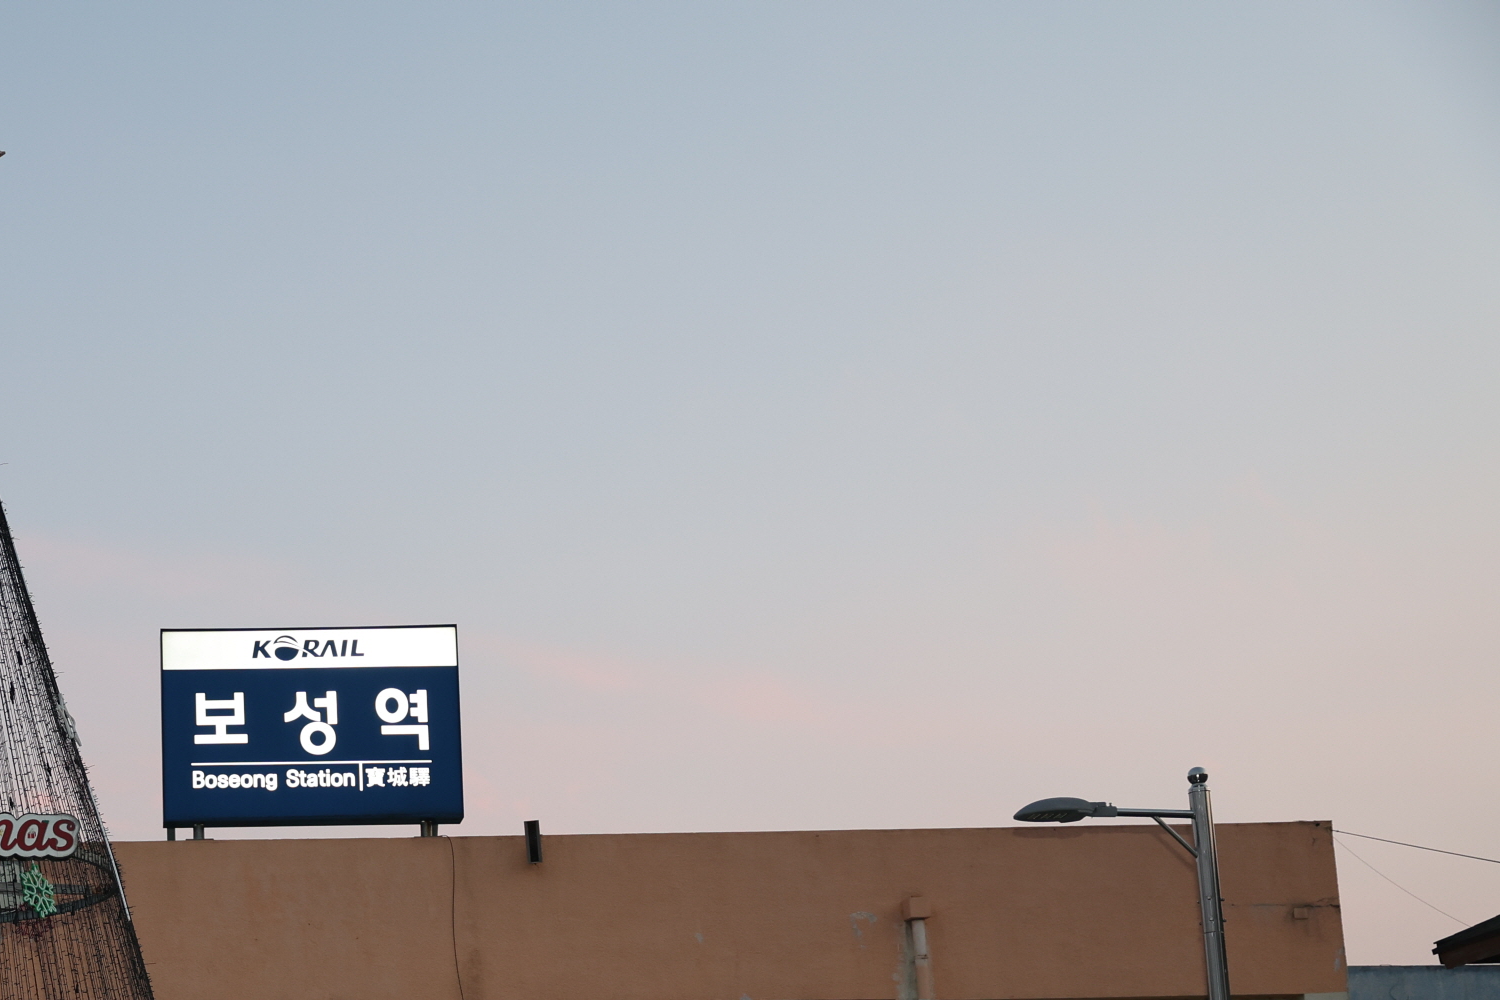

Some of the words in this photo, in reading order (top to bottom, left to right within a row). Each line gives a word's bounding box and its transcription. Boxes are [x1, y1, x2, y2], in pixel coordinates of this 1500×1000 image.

[252, 635, 365, 661] KORAIL
[193, 687, 430, 755] 보성역
[192, 770, 278, 791] Boseong
[286, 768, 355, 788] Station
